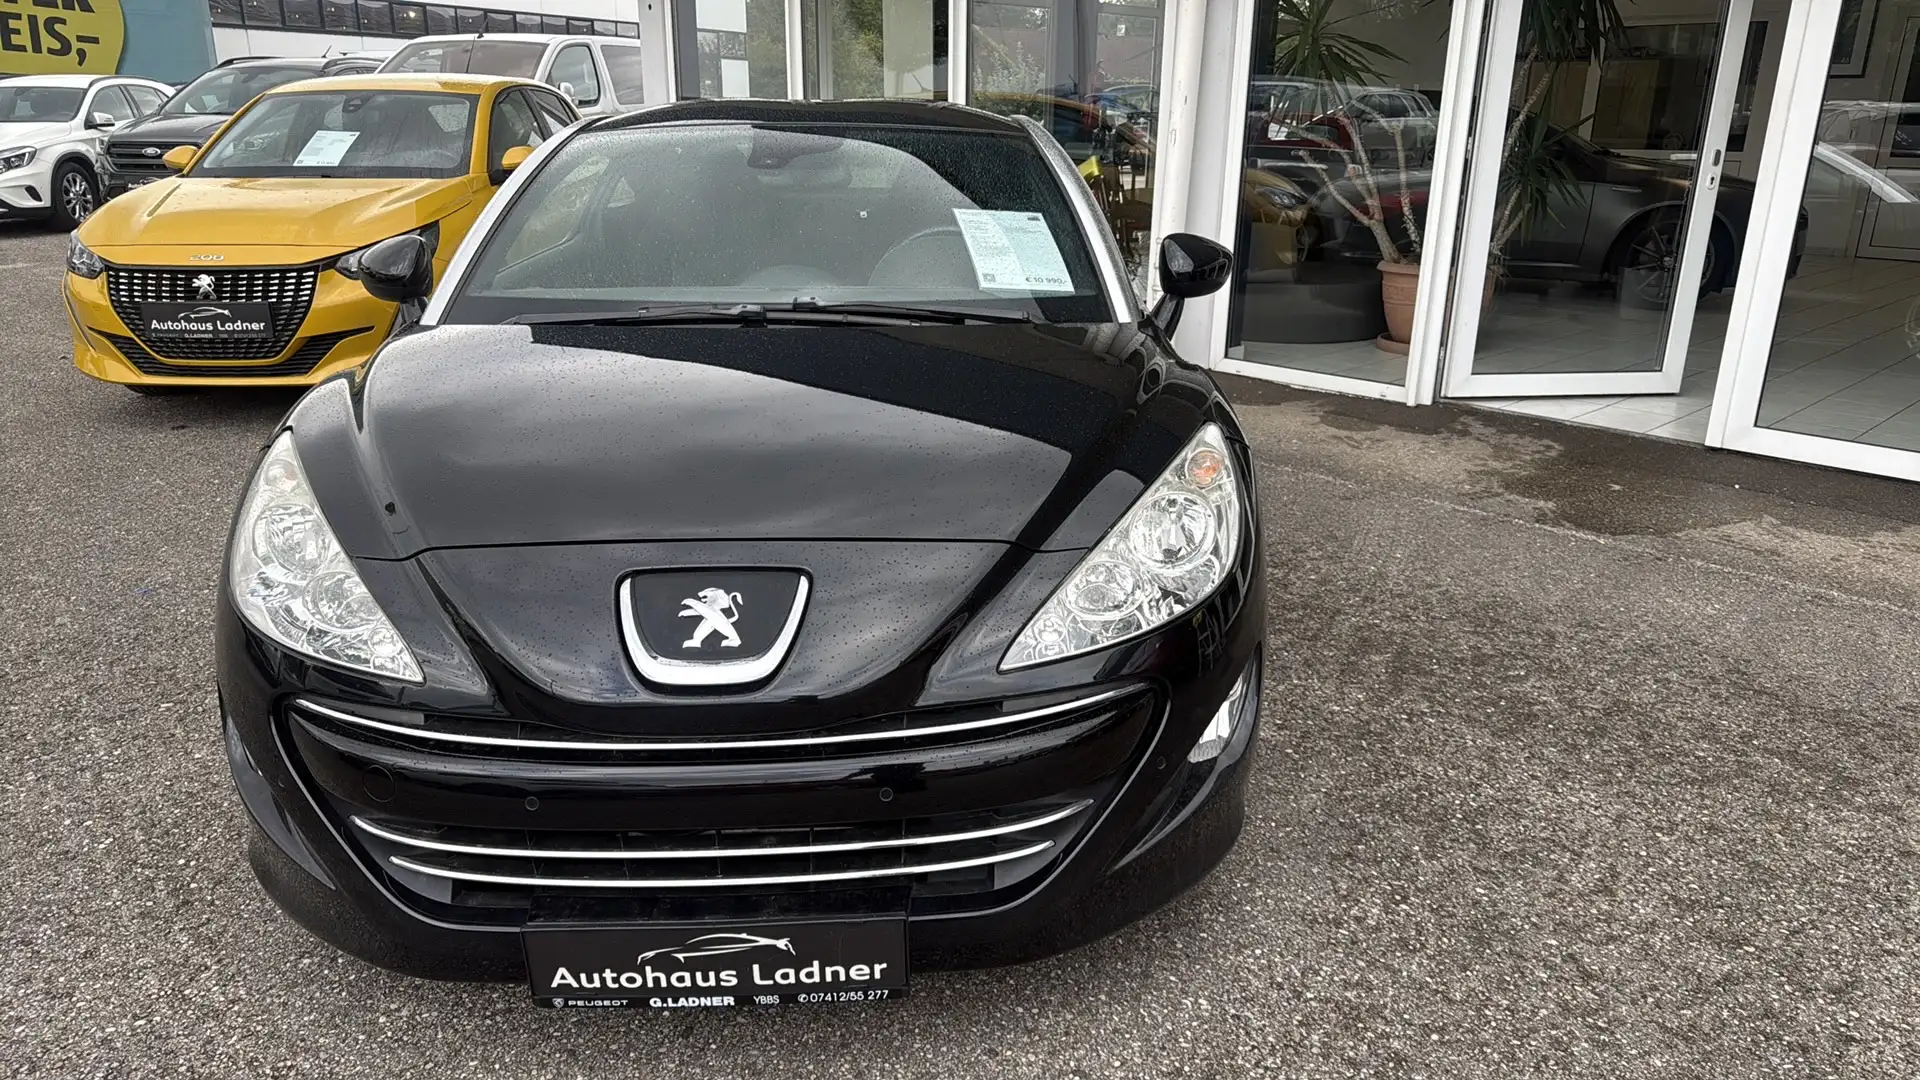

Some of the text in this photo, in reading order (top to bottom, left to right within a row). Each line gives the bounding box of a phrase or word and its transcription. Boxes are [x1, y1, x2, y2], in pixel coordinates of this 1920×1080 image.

[151, 319, 266, 331] Autohaus Ladner
[550, 960, 888, 989] Autohaus Ladner
[568, 990, 889, 1008] PEUGEOT G.LADNER YBBS 07412/55 277
